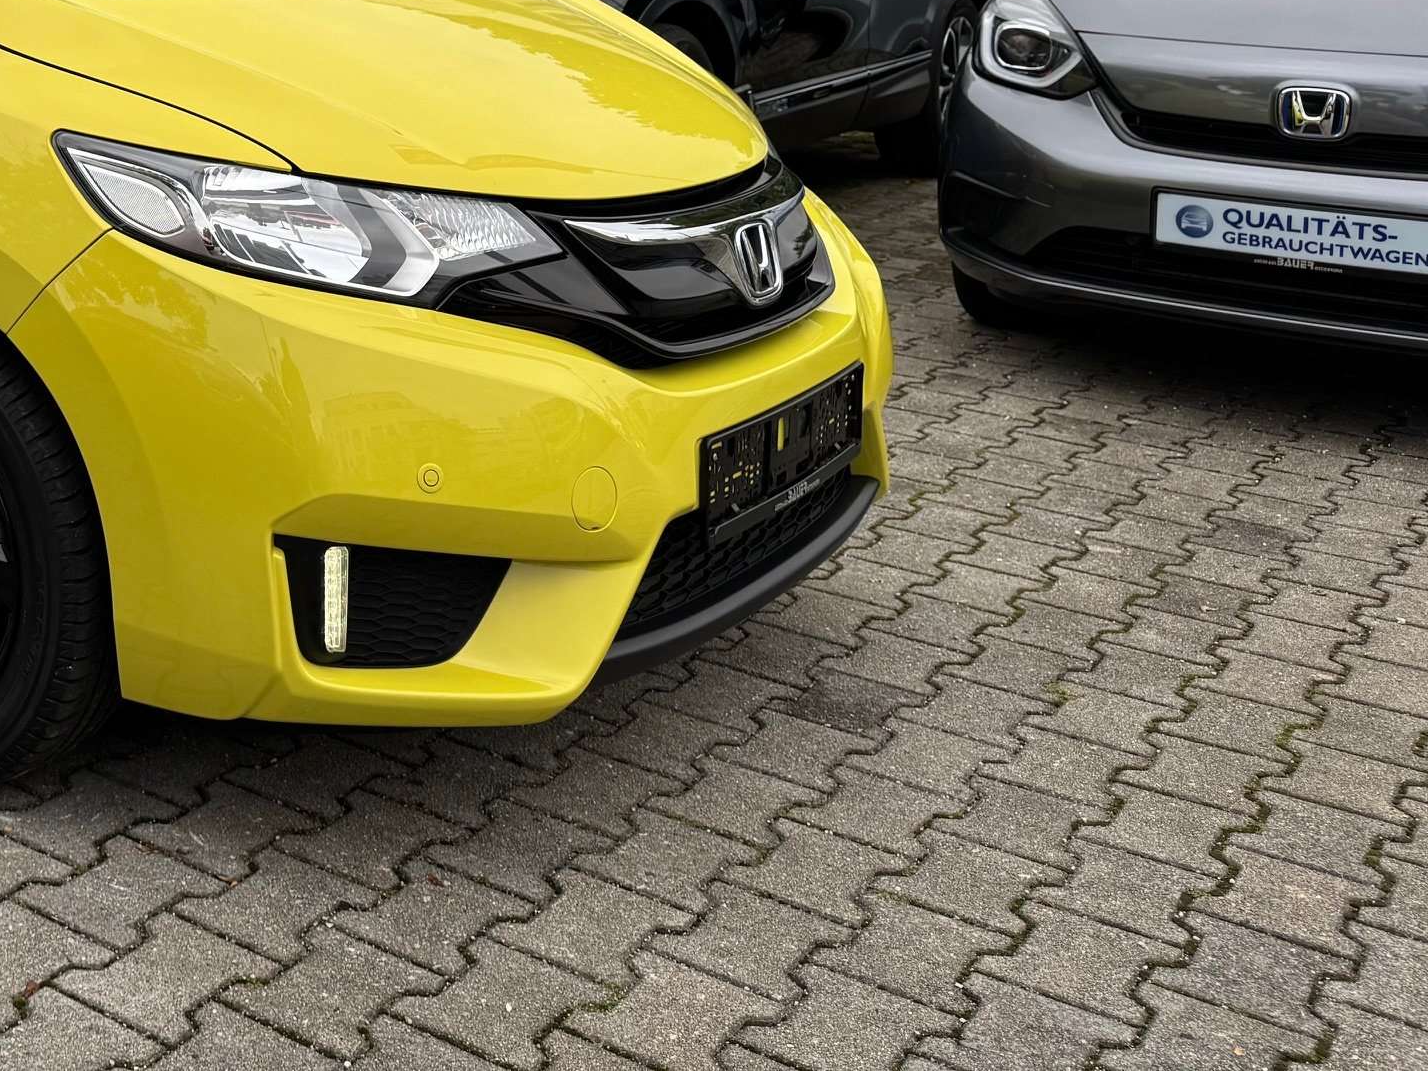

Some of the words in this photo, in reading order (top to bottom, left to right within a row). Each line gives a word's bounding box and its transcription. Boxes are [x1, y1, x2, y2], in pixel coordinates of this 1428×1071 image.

[1222, 208, 1398, 242] QUALITÄTS-
[1222, 231, 1428, 267] GEBRAUCHTWAGEN
[1277, 257, 1314, 271] BAUER
